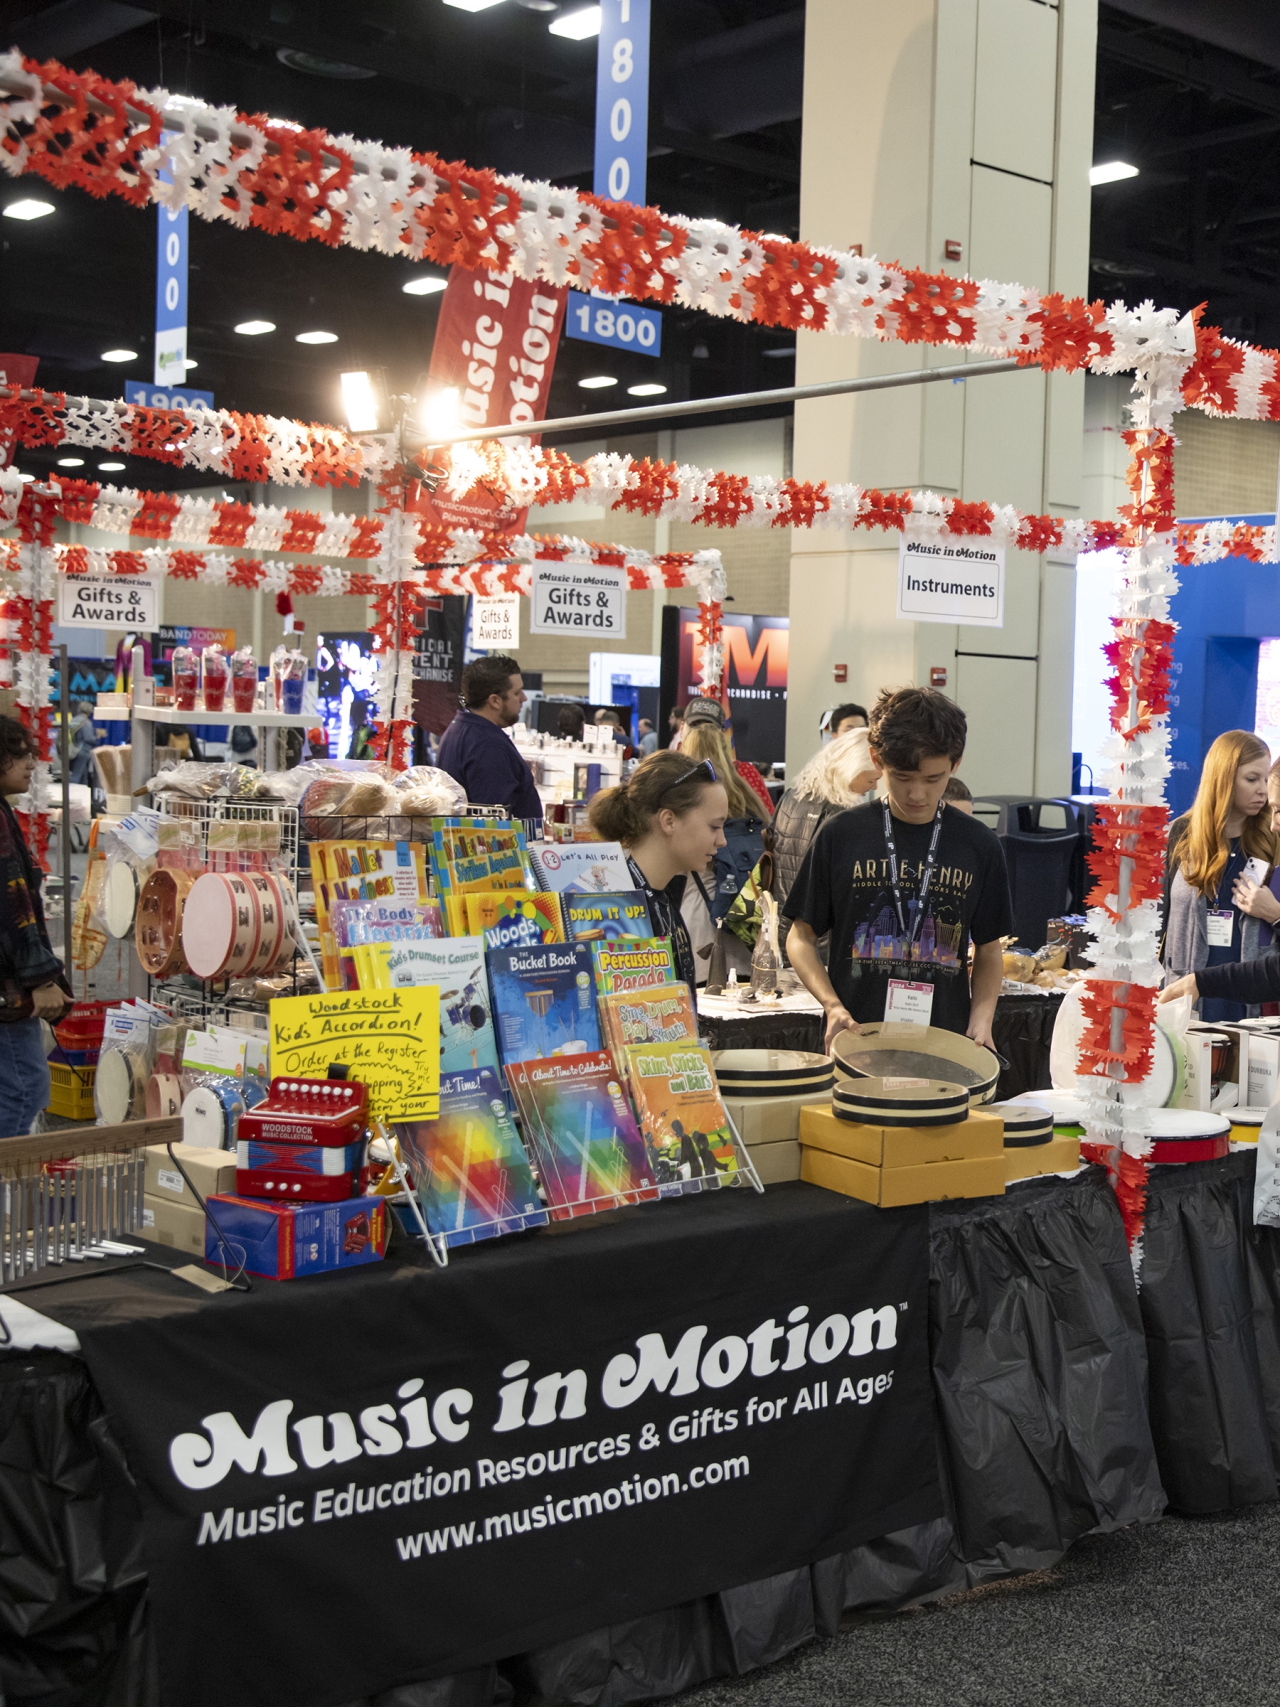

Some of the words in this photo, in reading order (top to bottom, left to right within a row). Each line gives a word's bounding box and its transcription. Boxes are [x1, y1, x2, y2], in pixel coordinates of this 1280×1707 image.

[575, 304, 657, 348] 1800
[460, 314, 503, 425] usic
[504, 293, 558, 436] otion
[431, 497, 517, 521] musicmotion.com
[442, 512, 470, 526] Plano,
[907, 542, 942, 555] Music
[943, 546, 955, 557] in
[956, 548, 997, 561] Motion
[66, 573, 101, 585] Music
[102, 576, 114, 585] in
[114, 577, 152, 588] Motion
[538, 572, 571, 584] Music
[572, 574, 583, 584] in
[583, 576, 620, 588] Motion
[907, 575, 996, 598] Instruments
[77, 587, 123, 605] Gifts
[128, 590, 142, 606] &
[548, 587, 592, 608] Gifts
[596, 591, 610, 608] &
[72, 603, 147, 624] Awards
[481, 609, 502, 624] Gifts
[503, 611, 511, 624] &
[543, 606, 614, 629] Awards
[478, 624, 513, 641] Awards
[442, 837, 479, 861] Mallet
[479, 834, 519, 855] Madness
[561, 852, 582, 862] Let's
[585, 853, 598, 862] All
[600, 853, 619, 863] Play
[334, 846, 384, 878] Mallet
[455, 858, 489, 883] Strikes
[489, 851, 522, 874] Again!
[333, 875, 395, 900] Madness
[852, 880, 882, 888] MIDDLE
[345, 906, 375, 921] The
[379, 906, 416, 923] Body
[570, 905, 603, 922] DRUM
[608, 908, 619, 920] IT
[625, 905, 647, 918] UP!
[349, 922, 435, 943] Electric
[485, 917, 540, 948] Woods,
[387, 951, 408, 970] Kid's
[408, 949, 447, 965] Drumset
[449, 951, 480, 965] Course
[509, 954, 548, 972] Bucket
[549, 951, 577, 968] Book
[601, 950, 669, 971] Percussion
[612, 967, 665, 993] Parade
[310, 992, 403, 1014] Woodstock
[647, 1000, 683, 1019] Drum,
[275, 1021, 312, 1045] Kid's
[321, 1012, 422, 1036] Accordion!
[622, 1022, 647, 1040] Play
[649, 1016, 662, 1028] and
[652, 1021, 686, 1043] Strum
[286, 1052, 328, 1073] Order
[335, 1046, 350, 1062] at
[354, 1042, 371, 1058] the
[378, 1041, 428, 1062] Register
[414, 1060, 430, 1075] Try
[637, 1056, 673, 1077] Skins,
[670, 1053, 709, 1075] Sticks,
[418, 1074, 430, 1084] me
[532, 1064, 554, 1081] About
[554, 1063, 571, 1077] Time
[571, 1064, 579, 1075] to
[579, 1060, 612, 1075] Celebrate!
[453, 1076, 481, 1093] Time!
[669, 1079, 686, 1094] and
[686, 1072, 713, 1092] Bars
[400, 1100, 430, 1115] your
[262, 1123, 313, 1134] WOODSTOCK
[169, 1377, 474, 1490] Music
[492, 1358, 588, 1434] in
[197, 1498, 306, 1547] Music
[314, 1465, 472, 1524] Education
[477, 1432, 632, 1489] Resources
[638, 1423, 661, 1452] &
[668, 1406, 739, 1445] Gifts
[745, 1390, 789, 1425] for
[792, 1381, 830, 1415] All
[836, 1367, 896, 1405] Ages
[396, 1452, 751, 1561] www.musicmotion.com
